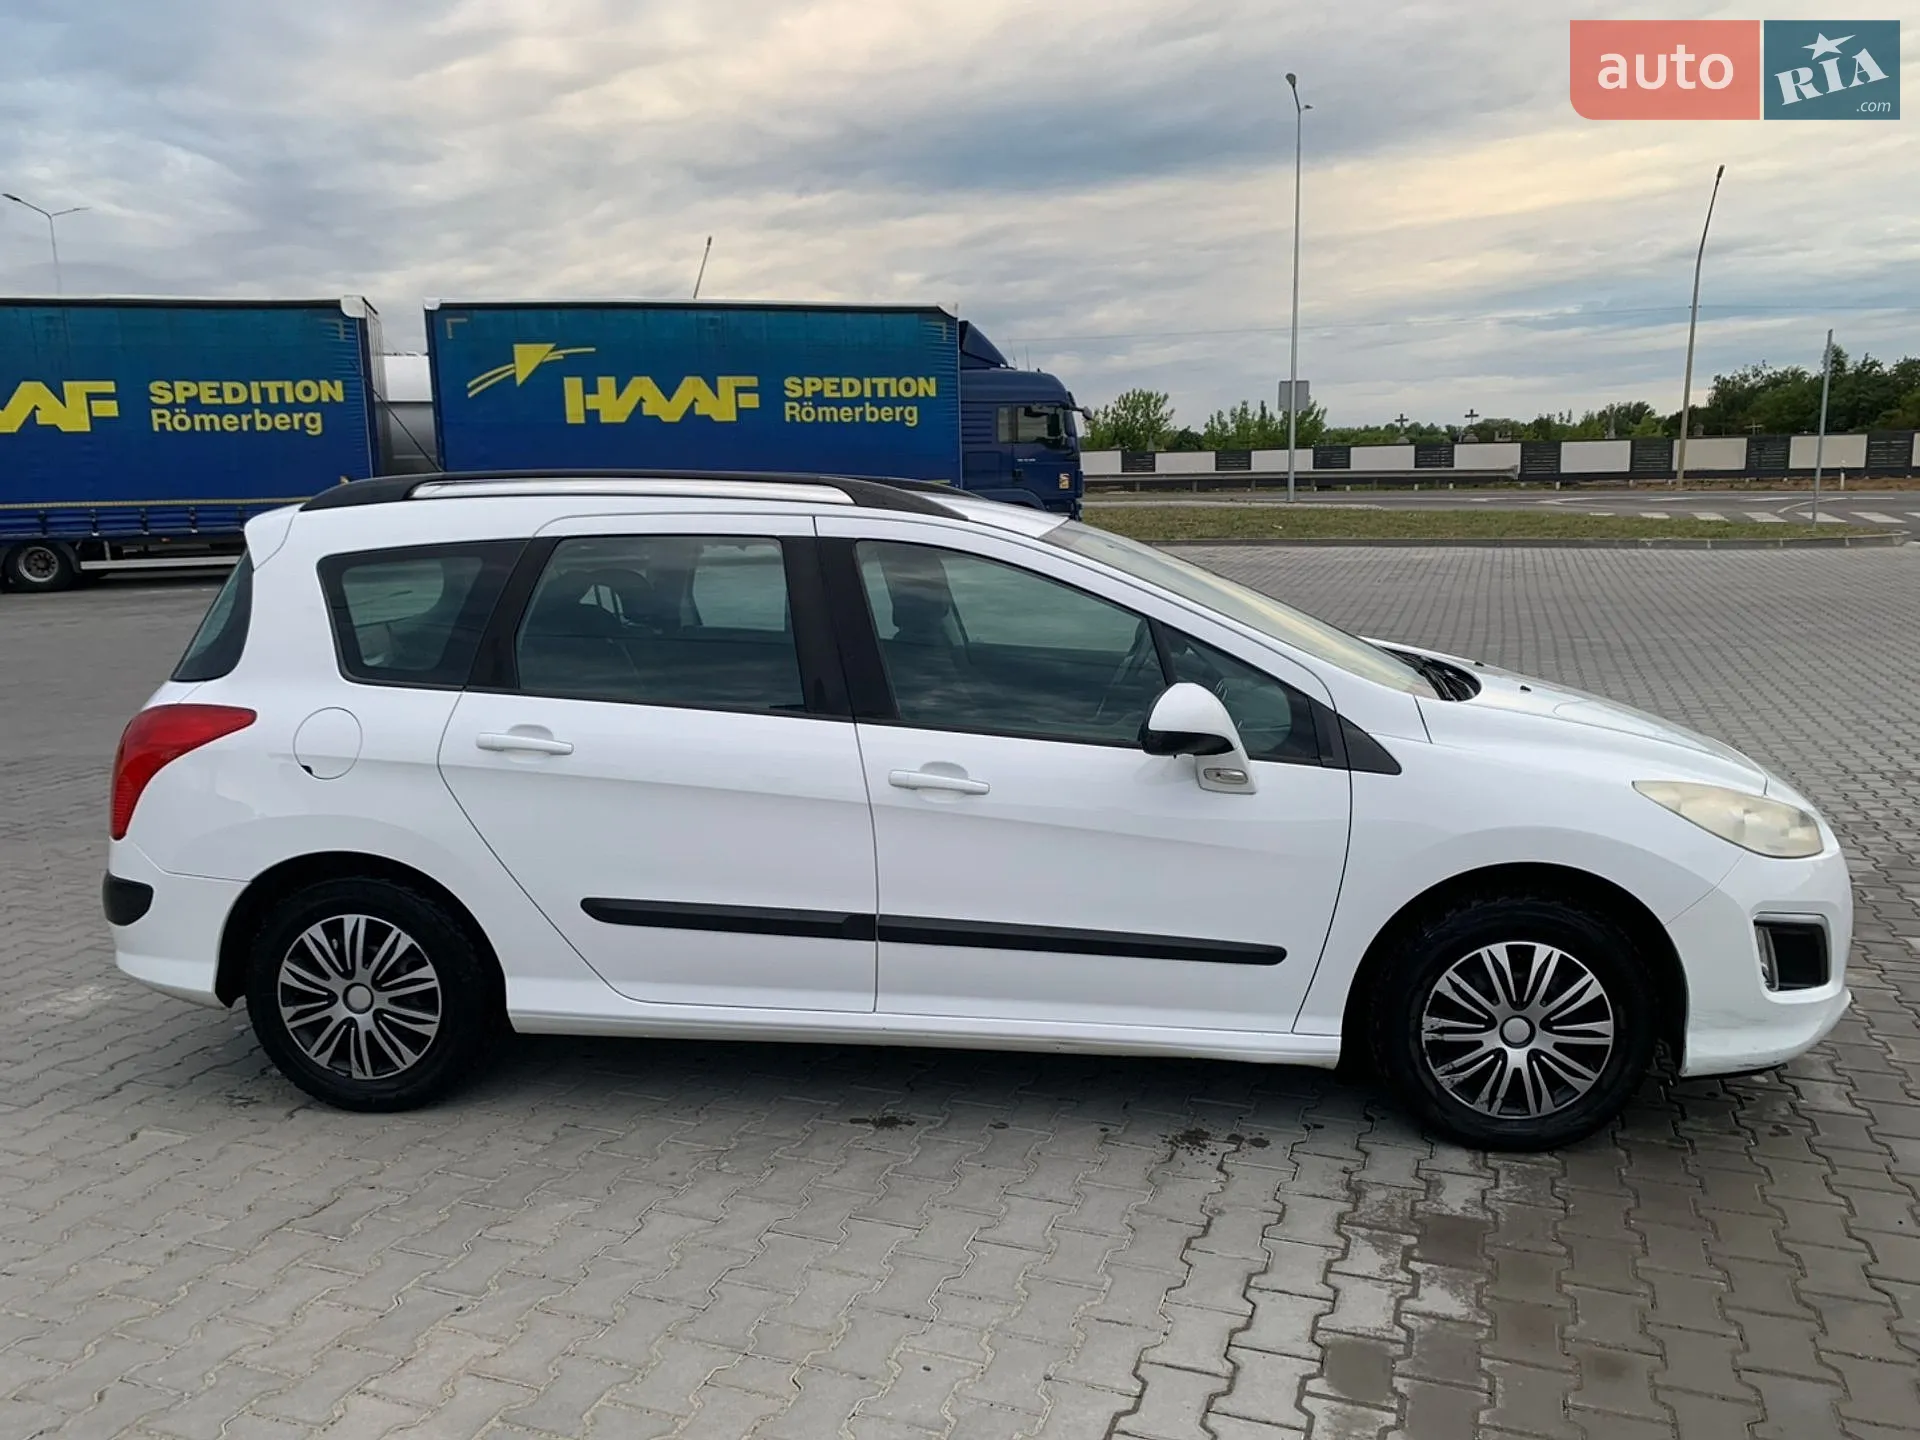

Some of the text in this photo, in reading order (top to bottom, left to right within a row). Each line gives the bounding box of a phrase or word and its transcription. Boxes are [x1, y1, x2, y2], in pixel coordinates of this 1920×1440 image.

[148, 379, 345, 405] SPEDITION
[563, 376, 760, 424] HAAF
[783, 376, 937, 399] SPEDITION
[0, 381, 119, 432] AF
[783, 401, 919, 427] Römerberg
[150, 409, 323, 436] Römerberg
